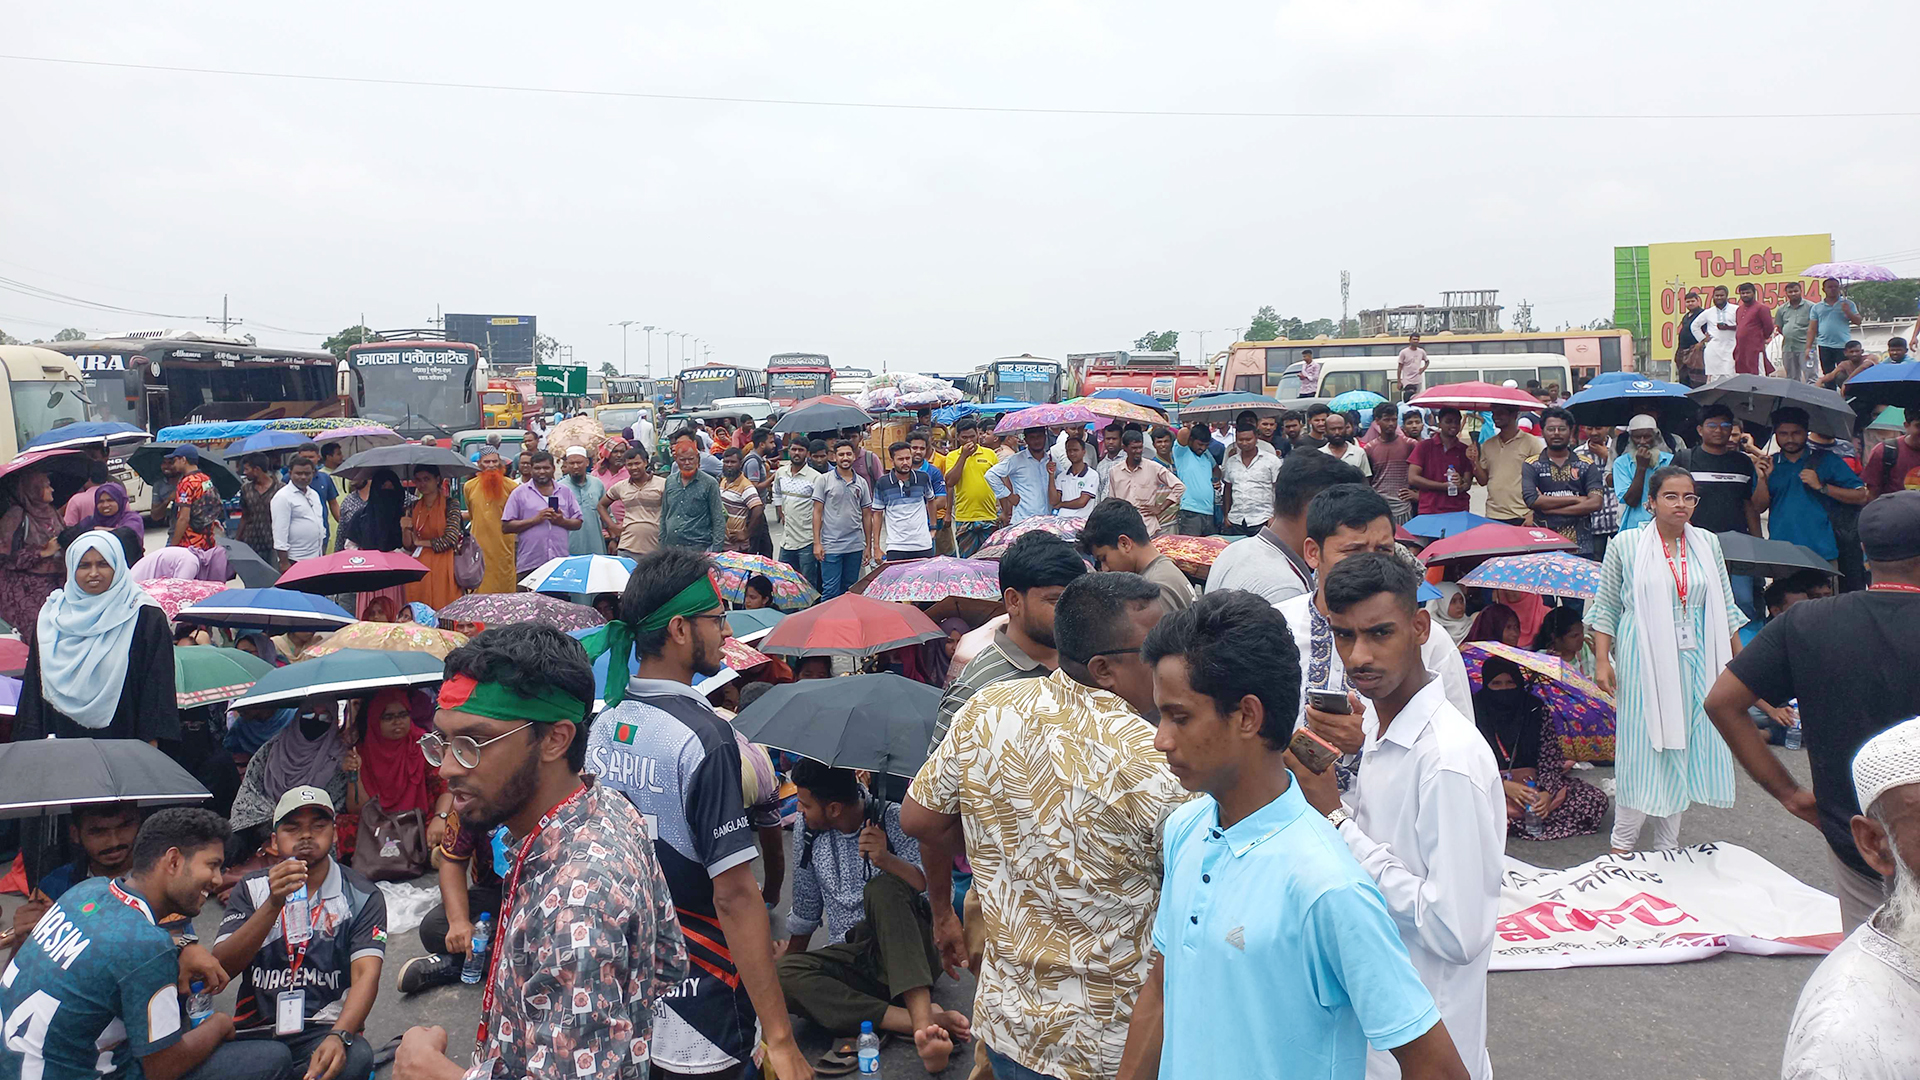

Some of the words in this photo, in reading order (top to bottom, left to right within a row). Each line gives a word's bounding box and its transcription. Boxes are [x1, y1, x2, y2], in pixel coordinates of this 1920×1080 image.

[1695, 247, 1783, 277] To-Let:
[356, 353, 400, 365] ফাতেমা
[681, 369, 735, 381] SHANTO
[713, 816, 750, 839] BANGLADE
[1569, 862, 1664, 893] দাবিতে
[31, 902, 91, 971] NASIM
[252, 965, 342, 990] ANAGEMENT
